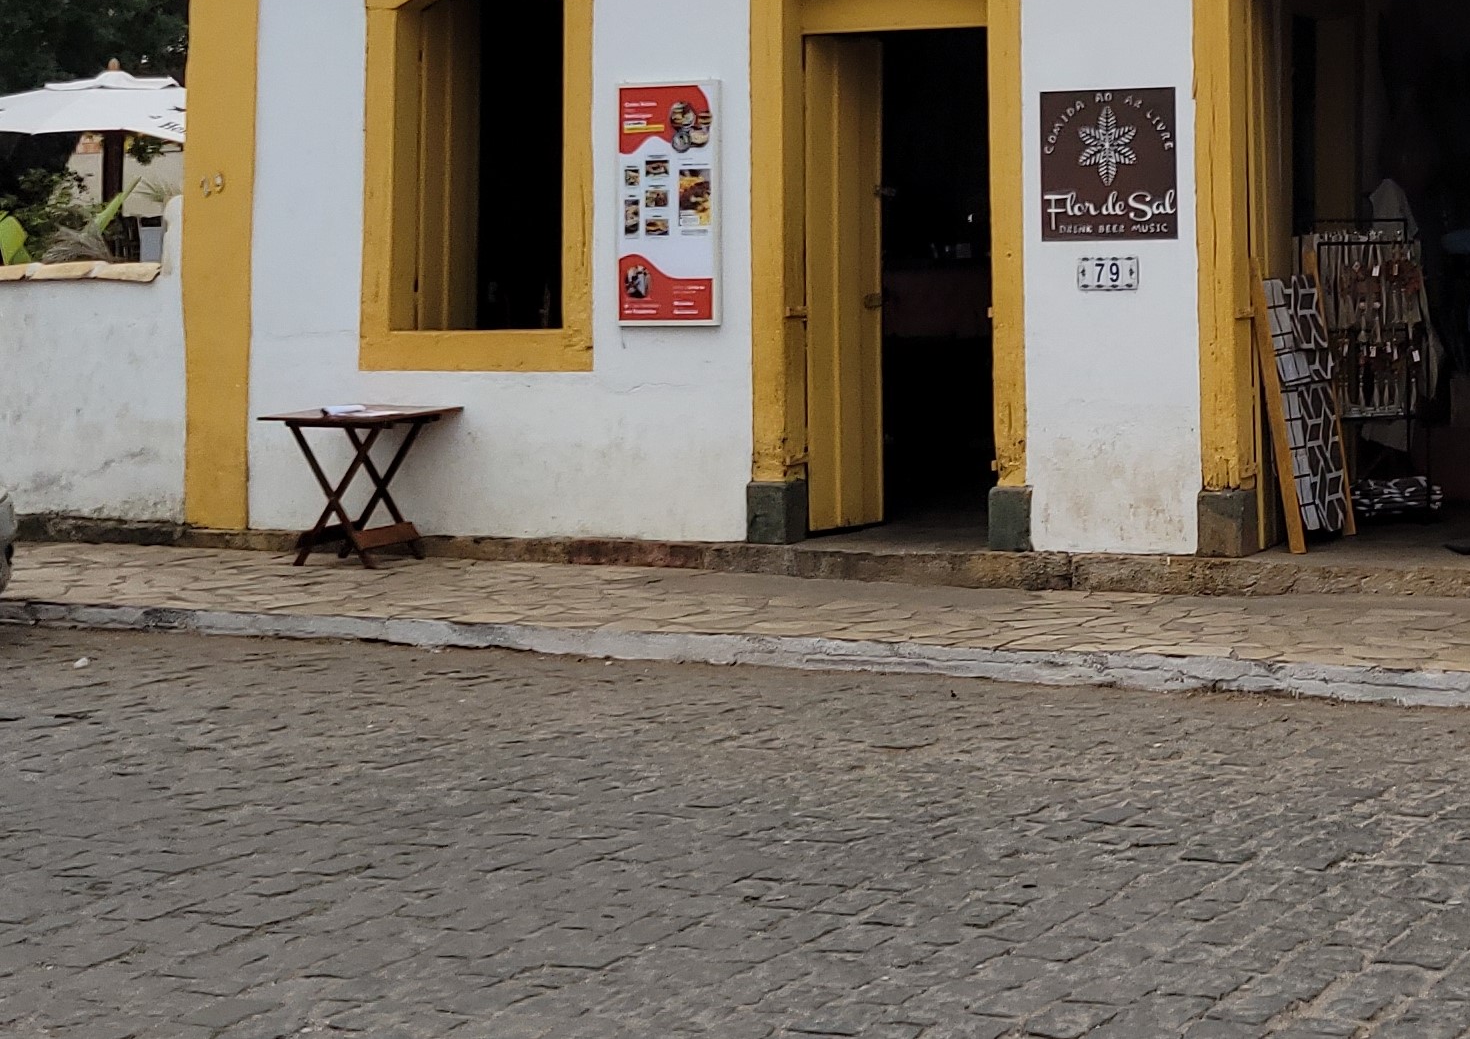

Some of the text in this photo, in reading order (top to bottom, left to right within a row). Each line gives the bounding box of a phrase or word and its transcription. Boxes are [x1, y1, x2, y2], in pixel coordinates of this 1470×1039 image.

[1043, 92, 1174, 155] COMIDA AO AR LIVRE
[1043, 189, 1176, 231] Flor de Sal
[1098, 224, 1126, 234] BEER
[1131, 223, 1169, 234] MUSIC
[1094, 262, 1120, 283] 79
